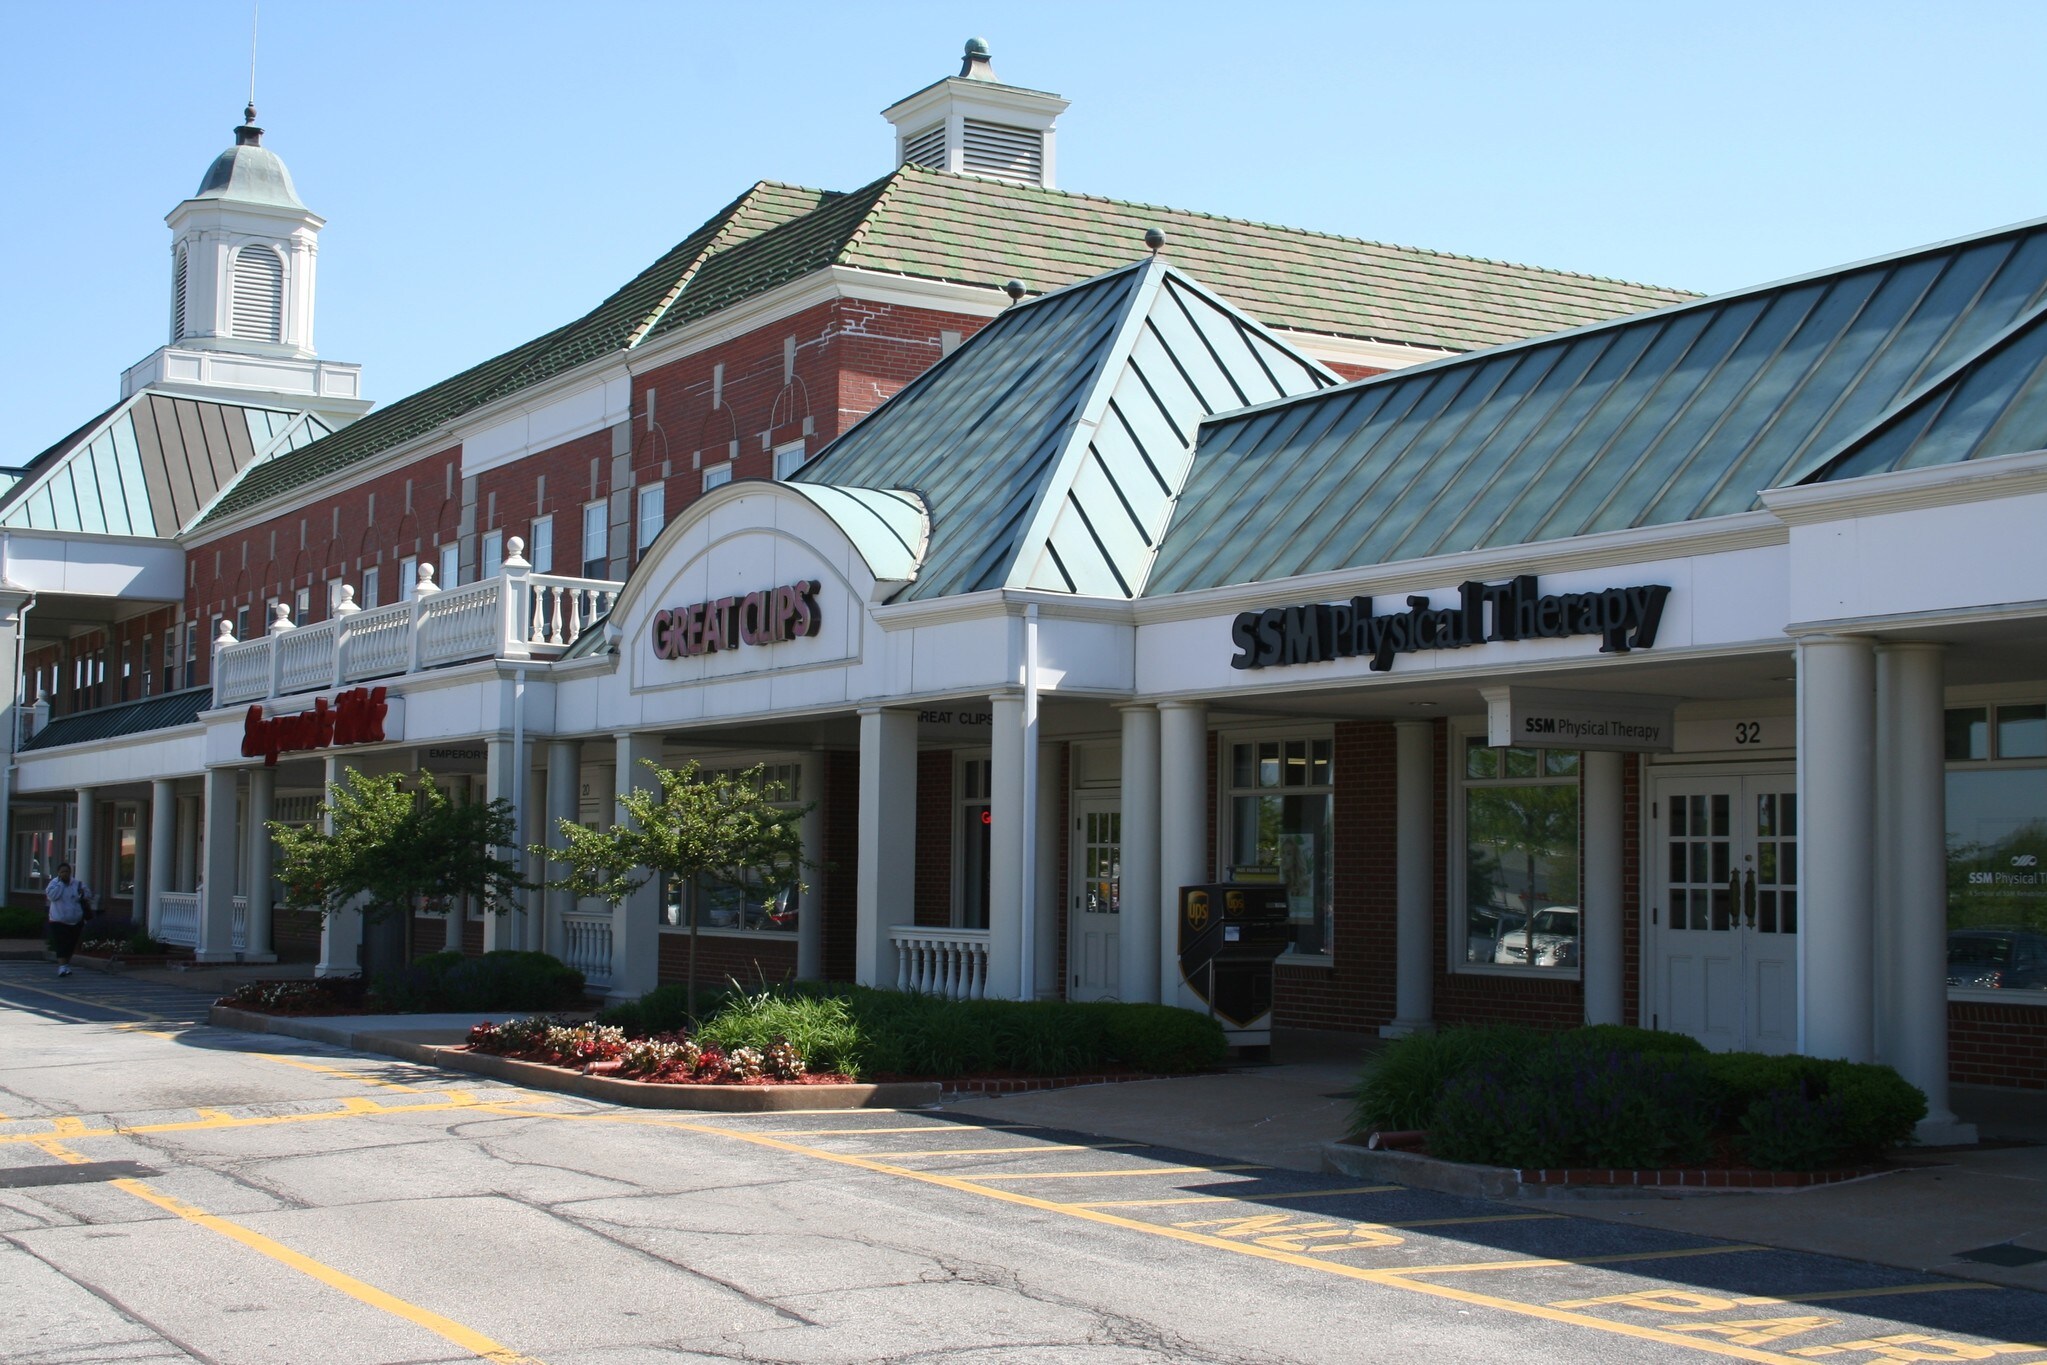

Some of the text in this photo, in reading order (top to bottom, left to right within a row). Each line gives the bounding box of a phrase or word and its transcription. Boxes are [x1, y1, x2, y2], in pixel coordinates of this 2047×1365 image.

[652, 580, 821, 660] GREAT CLIPS
[1230, 575, 1671, 671] SSM Physical Therapy
[917, 711, 953, 724] REAT
[1525, 718, 1660, 741] SSM Physical Therapy
[1735, 722, 1761, 744] 32
[1968, 872, 1993, 884] SSM
[1995, 872, 2038, 887] Physical
[1189, 903, 1208, 925] ups
[1227, 897, 1244, 913] ups
